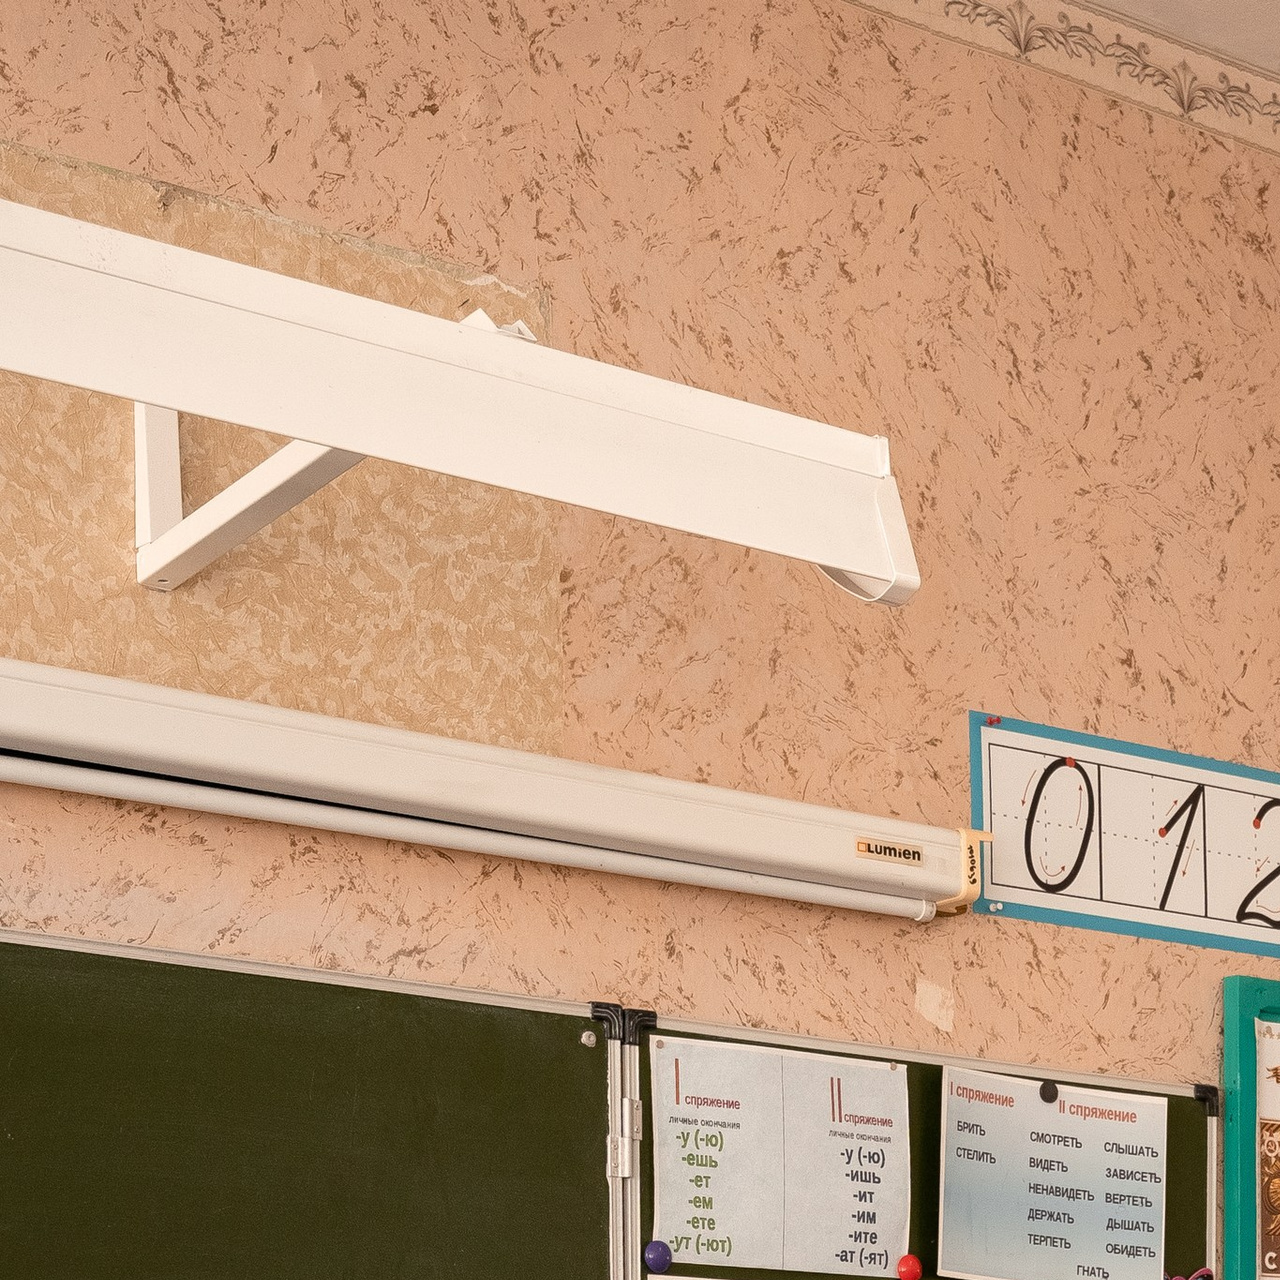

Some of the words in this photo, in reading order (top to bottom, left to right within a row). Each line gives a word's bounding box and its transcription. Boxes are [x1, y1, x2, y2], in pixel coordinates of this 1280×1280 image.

[1024, 757, 1095, 893] 0
[1159, 784, 1205, 911] 1
[867, 843, 921, 861] Lumien
[684, 1095, 741, 1110] спряжение
[956, 1085, 1015, 1108] спряжение
[844, 1113, 893, 1128] спряжение
[1069, 1103, 1138, 1123] спряжение
[668, 1115, 699, 1126] личные
[700, 1119, 741, 1130] окончания
[957, 1120, 986, 1136] БРИТЬ
[694, 1129, 724, 1151] (-ю)
[828, 1129, 855, 1140] личные
[855, 1132, 892, 1144] окончания
[1030, 1131, 1083, 1149] СМОТРЕТЬ
[857, 1147, 886, 1168] (-ю)
[955, 1147, 997, 1164] СТЕЛИТЬ
[1103, 1142, 1159, 1158] СЛЫШАТЬ
[681, 1153, 719, 1168] -ешь
[1029, 1157, 1069, 1173] ВИДЕТЬ
[689, 1174, 711, 1188] -ет
[845, 1169, 882, 1184] -ишь
[1105, 1168, 1162, 1184] ЗАВИСЕТЬ
[853, 1190, 875, 1203] -ит
[1028, 1183, 1095, 1201] НЕНАВИДЕТЬ
[688, 1196, 713, 1210] -ем
[1105, 1193, 1153, 1208] ВЕРТЕТЬ
[686, 1217, 716, 1231] -ете
[851, 1211, 877, 1224] -им
[1027, 1208, 1075, 1224] ДЕРЖАТЬ
[1106, 1218, 1155, 1233] ДЫШАТЬ
[669, 1235, 691, 1252] -ут
[696, 1235, 732, 1256] (-ют)
[848, 1230, 878, 1245] -ите
[1027, 1233, 1072, 1249] ТЕРПЕТЬ
[834, 1249, 855, 1263] -ат
[859, 1248, 889, 1269] (-ят)
[1105, 1243, 1156, 1258] ОБИДЕТЬ
[1264, 1252, 1277, 1270] С
[1076, 1265, 1110, 1279] ГНАТЬ
